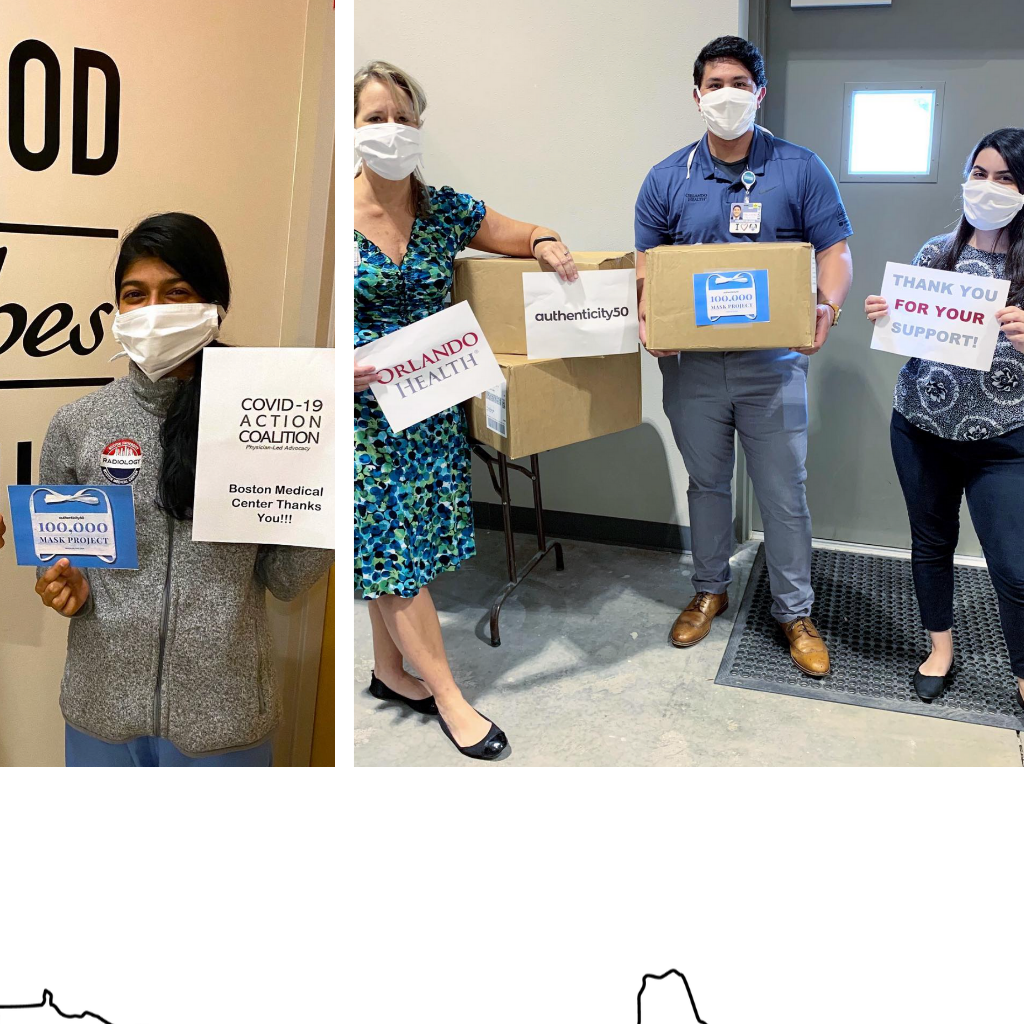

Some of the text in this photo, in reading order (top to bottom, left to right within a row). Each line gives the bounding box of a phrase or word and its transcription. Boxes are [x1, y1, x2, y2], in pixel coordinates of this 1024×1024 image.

[893, 274, 998, 302] THANK YOU
[535, 306, 629, 322] authenticity50
[895, 299, 985, 325] FOR YOUR
[891, 322, 979, 349] SUPPORT!
[376, 332, 479, 384] ORLANDO
[239, 414, 322, 429] ACTION
[238, 430, 320, 444] COALITION
[229, 484, 324, 497] Boston Medical
[231, 498, 322, 512] Center Thanks
[257, 513, 292, 524] You!!!
[38, 522, 108, 534] 100,000
[39, 536, 109, 545] MASK PROJECT
